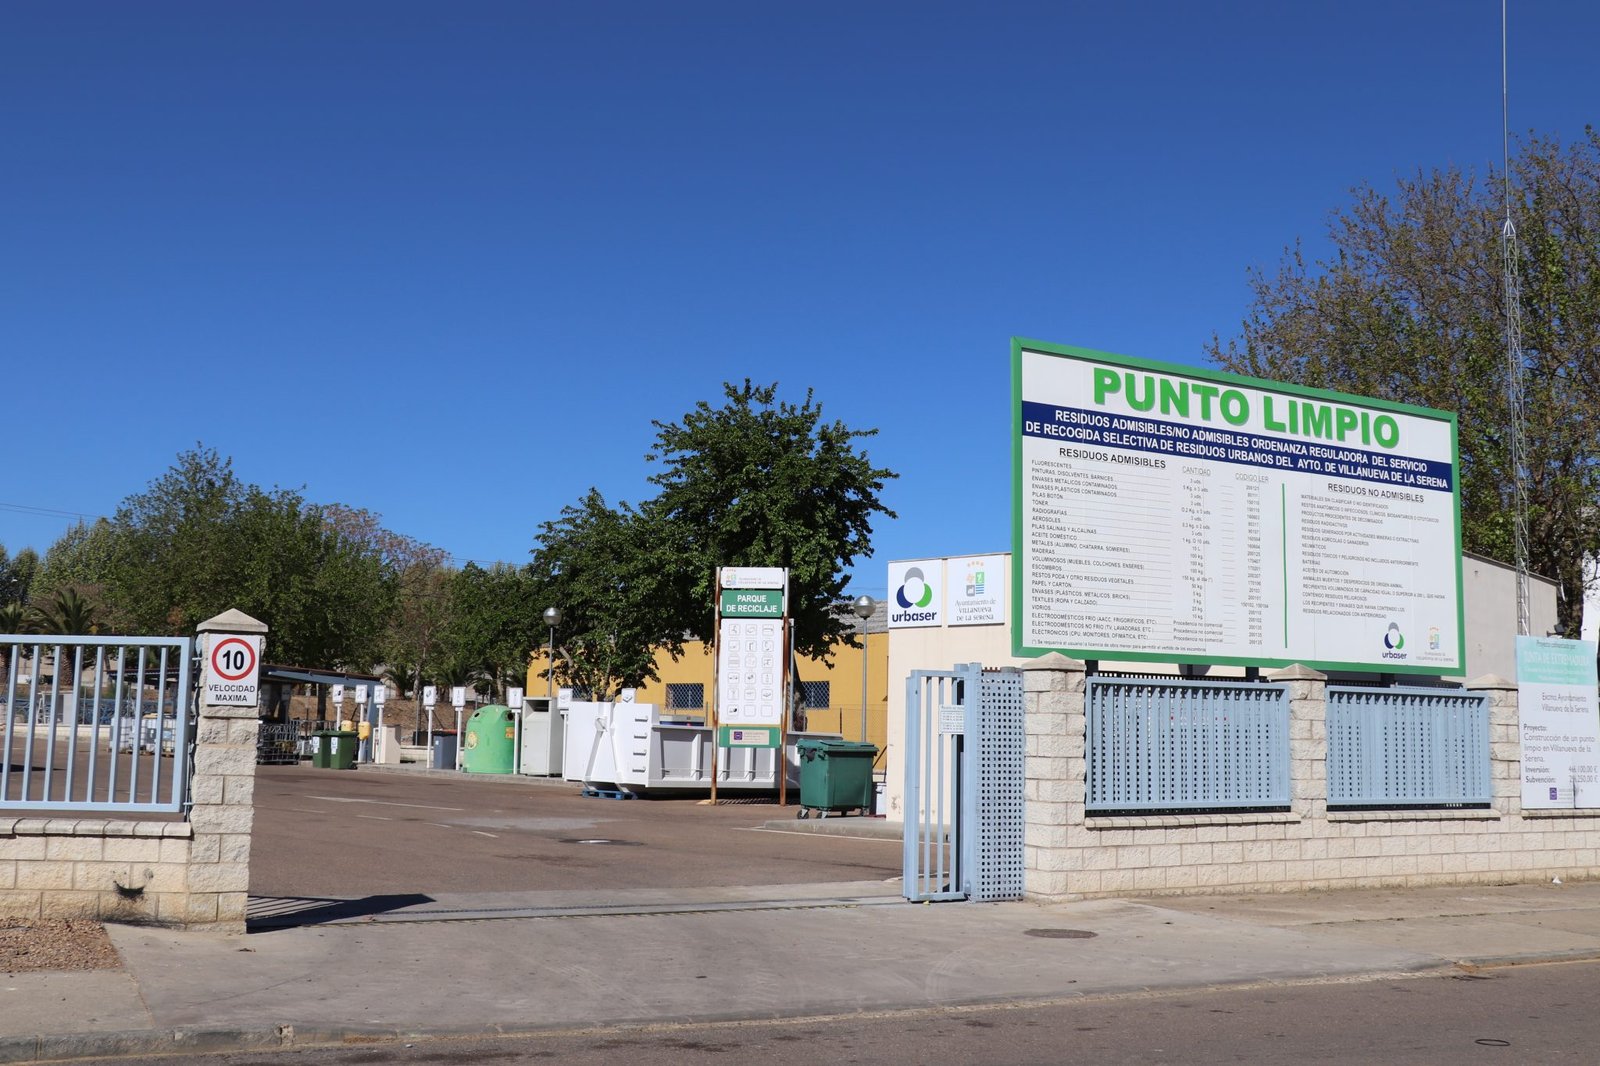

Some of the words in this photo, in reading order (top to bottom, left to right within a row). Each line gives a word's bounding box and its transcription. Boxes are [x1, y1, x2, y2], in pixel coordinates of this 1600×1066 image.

[1093, 367, 1250, 428] PUNTO
[1263, 395, 1400, 451] LIMPIO
[1055, 409, 1110, 429] RESIDUOS
[1112, 417, 1190, 440] ADMISIBLES/NO
[1192, 429, 1249, 448] ADMISIBLES
[1251, 438, 1308, 456] ORDENANZA
[1310, 446, 1368, 465] REGULADORA
[1372, 455, 1388, 468] DEL
[1390, 458, 1427, 473] SERVICIO
[1025, 420, 1043, 434] DE
[1044, 423, 1101, 442] RECOGIDA
[1102, 431, 1160, 450] SELECTIVA
[1160, 439, 1174, 452] DE
[1176, 441, 1227, 459] RESIDUOS
[1228, 448, 1274, 465] URBANOS
[1276, 455, 1294, 468] DEL
[1298, 458, 1323, 472] AYTO.
[1325, 462, 1337, 474] DE
[1338, 464, 1393, 482] VILLANUEVA
[1393, 471, 1404, 483] DE
[1404, 473, 1415, 484] LA
[1416, 475, 1448, 489] SERENA
[1059, 447, 1109, 462] RESIDUOS
[1111, 453, 1166, 469] ADMISIBLES
[1032, 459, 1072, 469] FLUORESCENTES
[1182, 465, 1211, 476] CANTIDAD
[1328, 483, 1366, 496] RESIDUOS
[1368, 488, 1379, 497] NO
[1381, 490, 1424, 503] ADMISIBLES
[737, 594, 767, 603] PARQUE
[892, 610, 937, 622] urbaser
[223, 650, 244, 670] 10
[1382, 651, 1408, 660] urbaser
[1524, 733, 1561, 741] Construcción
[1524, 744, 1541, 752] limpio
